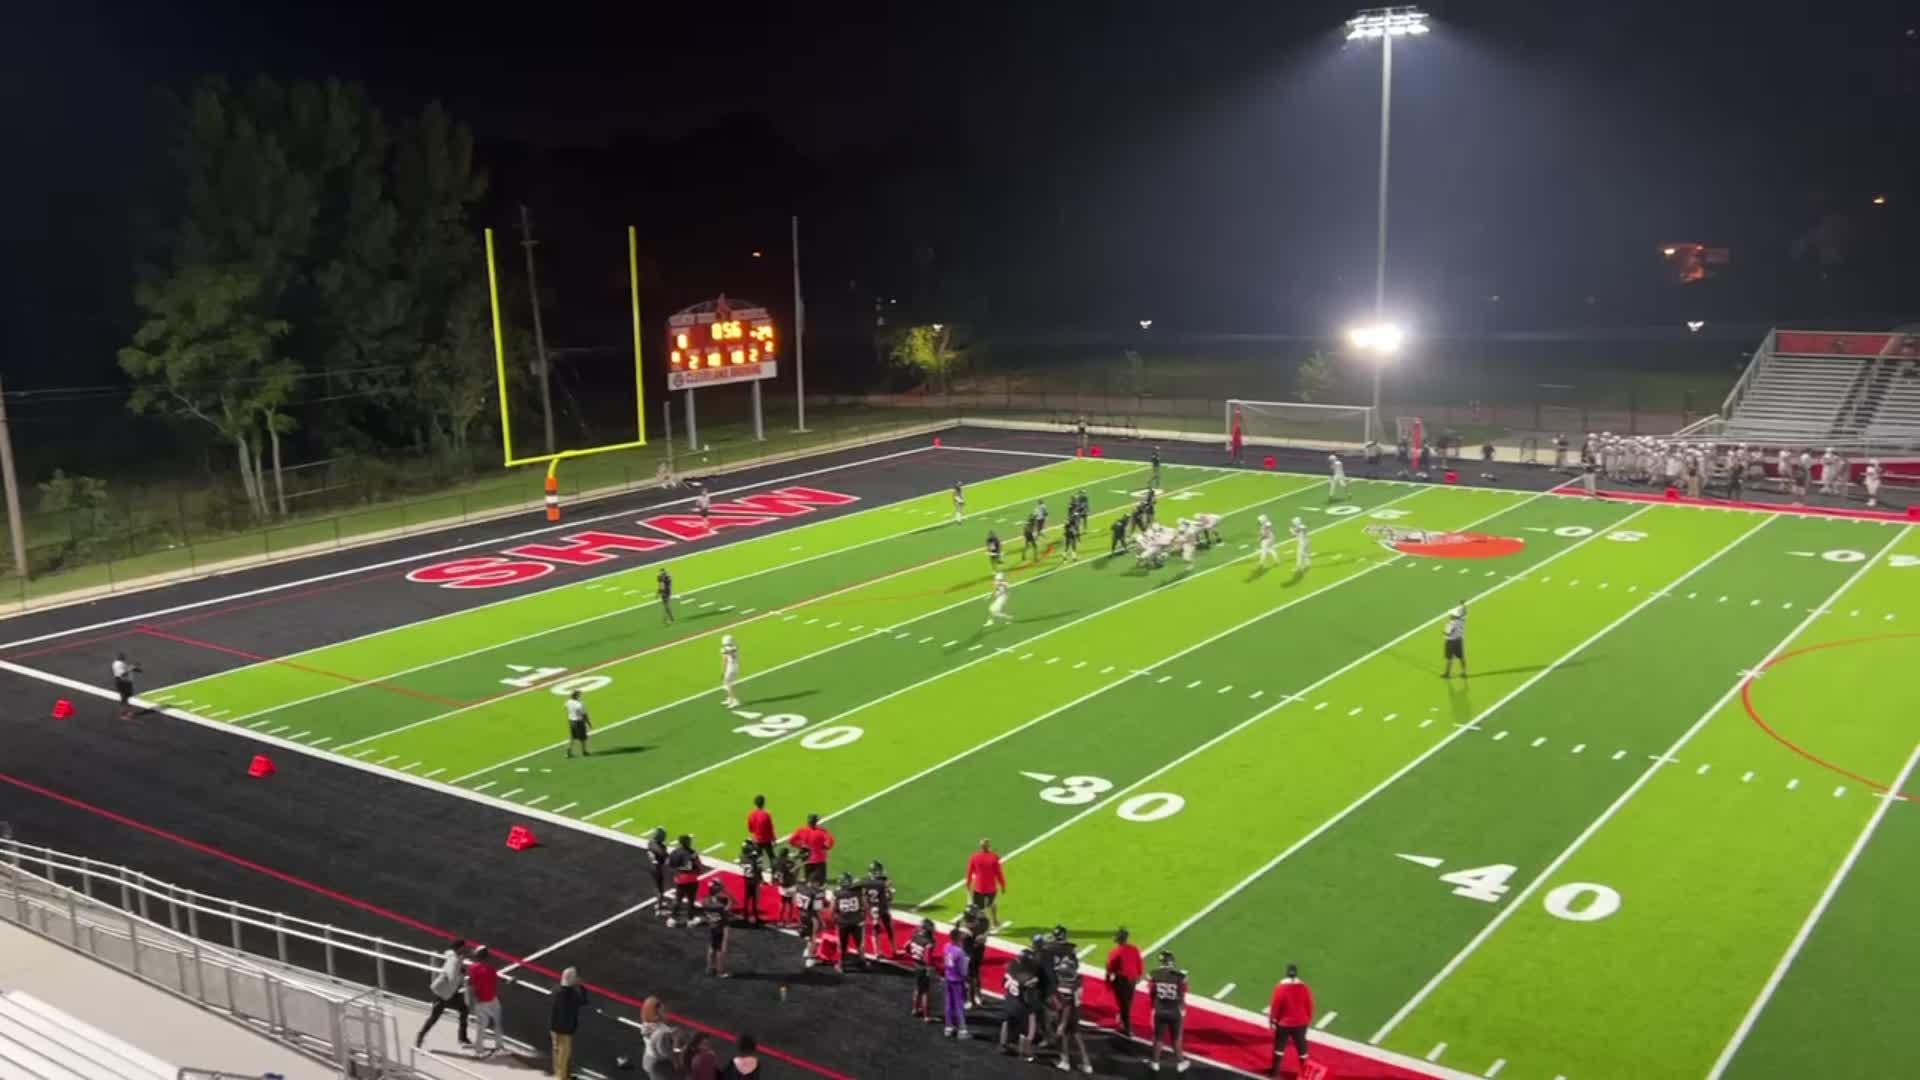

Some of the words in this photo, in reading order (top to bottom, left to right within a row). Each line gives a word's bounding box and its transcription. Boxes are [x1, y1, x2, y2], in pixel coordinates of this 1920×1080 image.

[405, 486, 861, 588] SHAW
[500, 667, 612, 696] 10
[732, 713, 864, 749] 20
[1039, 775, 1185, 822] 30
[1438, 863, 1621, 921] 40
